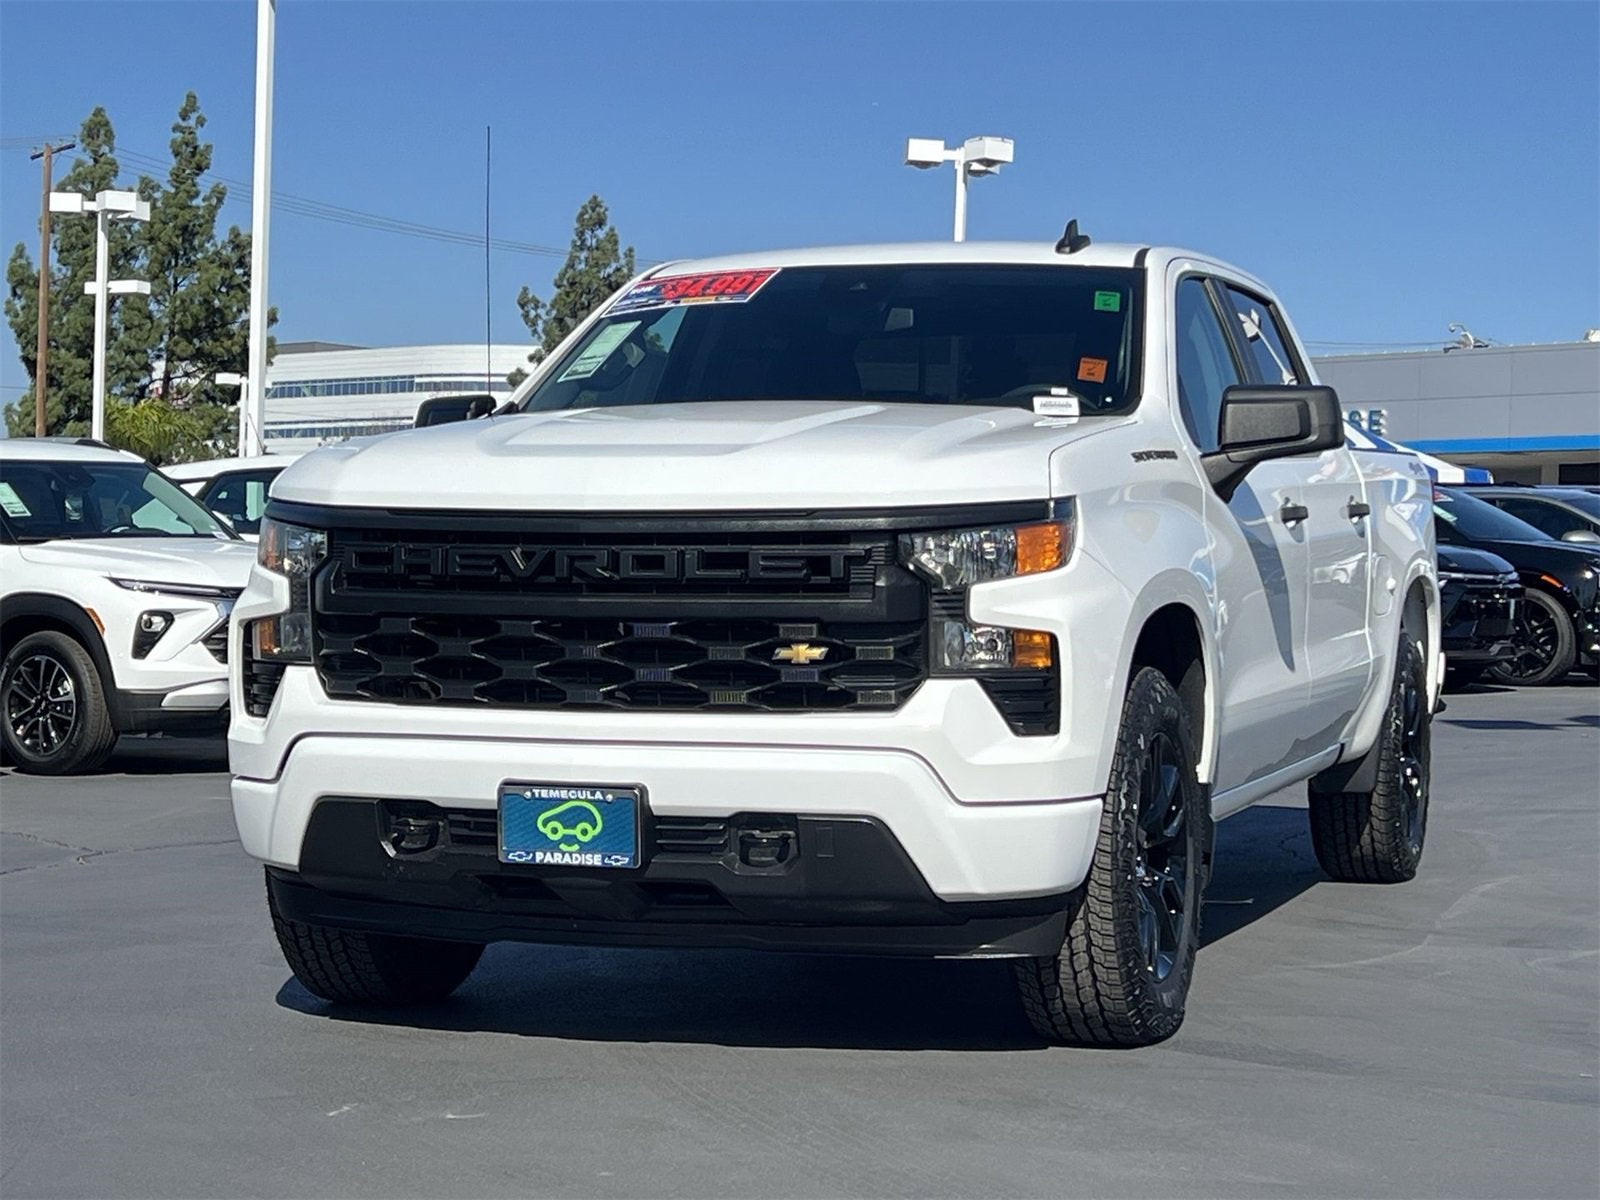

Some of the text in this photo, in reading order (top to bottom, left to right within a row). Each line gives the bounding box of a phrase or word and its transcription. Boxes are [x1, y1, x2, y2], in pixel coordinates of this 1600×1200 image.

[344, 543, 867, 584] CHEVROLET
[531, 788, 604, 801] TEMECULA
[535, 851, 602, 866] PARADISE
